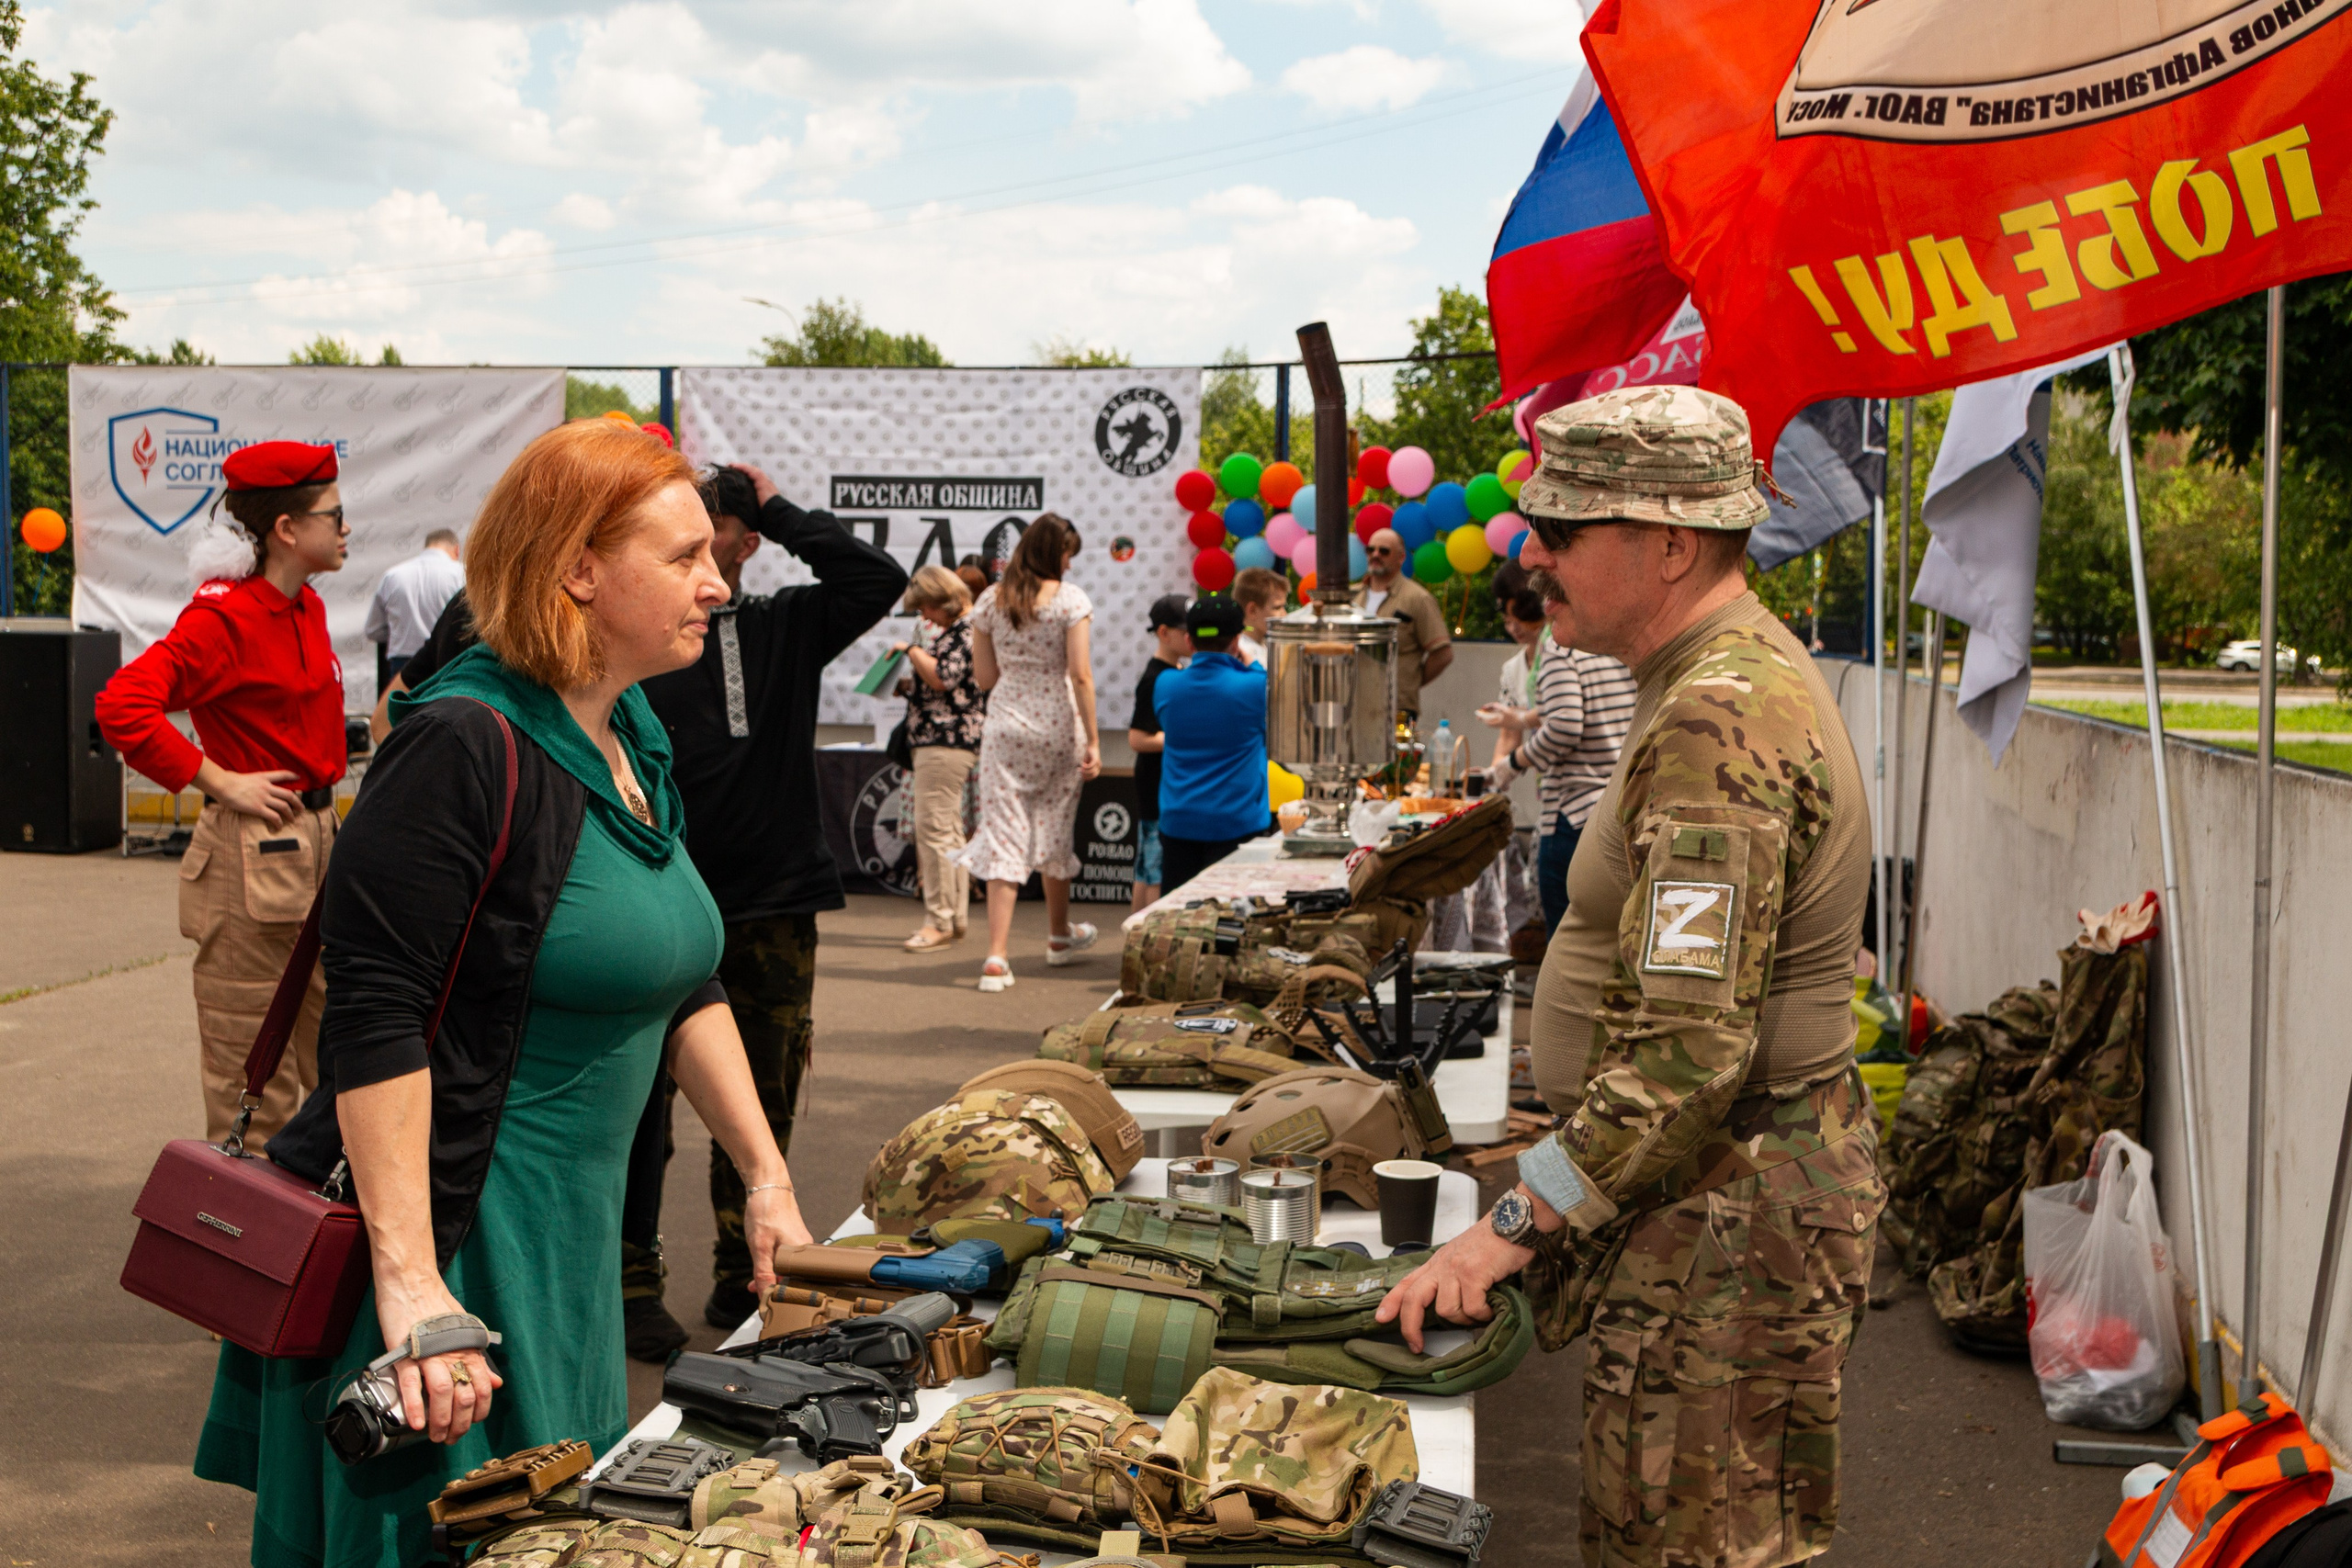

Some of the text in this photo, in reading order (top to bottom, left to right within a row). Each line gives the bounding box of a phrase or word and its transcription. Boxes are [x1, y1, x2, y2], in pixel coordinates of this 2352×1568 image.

[1102, 388, 1177, 420] РУССКАЯ
[834, 482, 1038, 510] РУССКАЯ ОБЩИНА
[1657, 887, 1721, 949] Z
